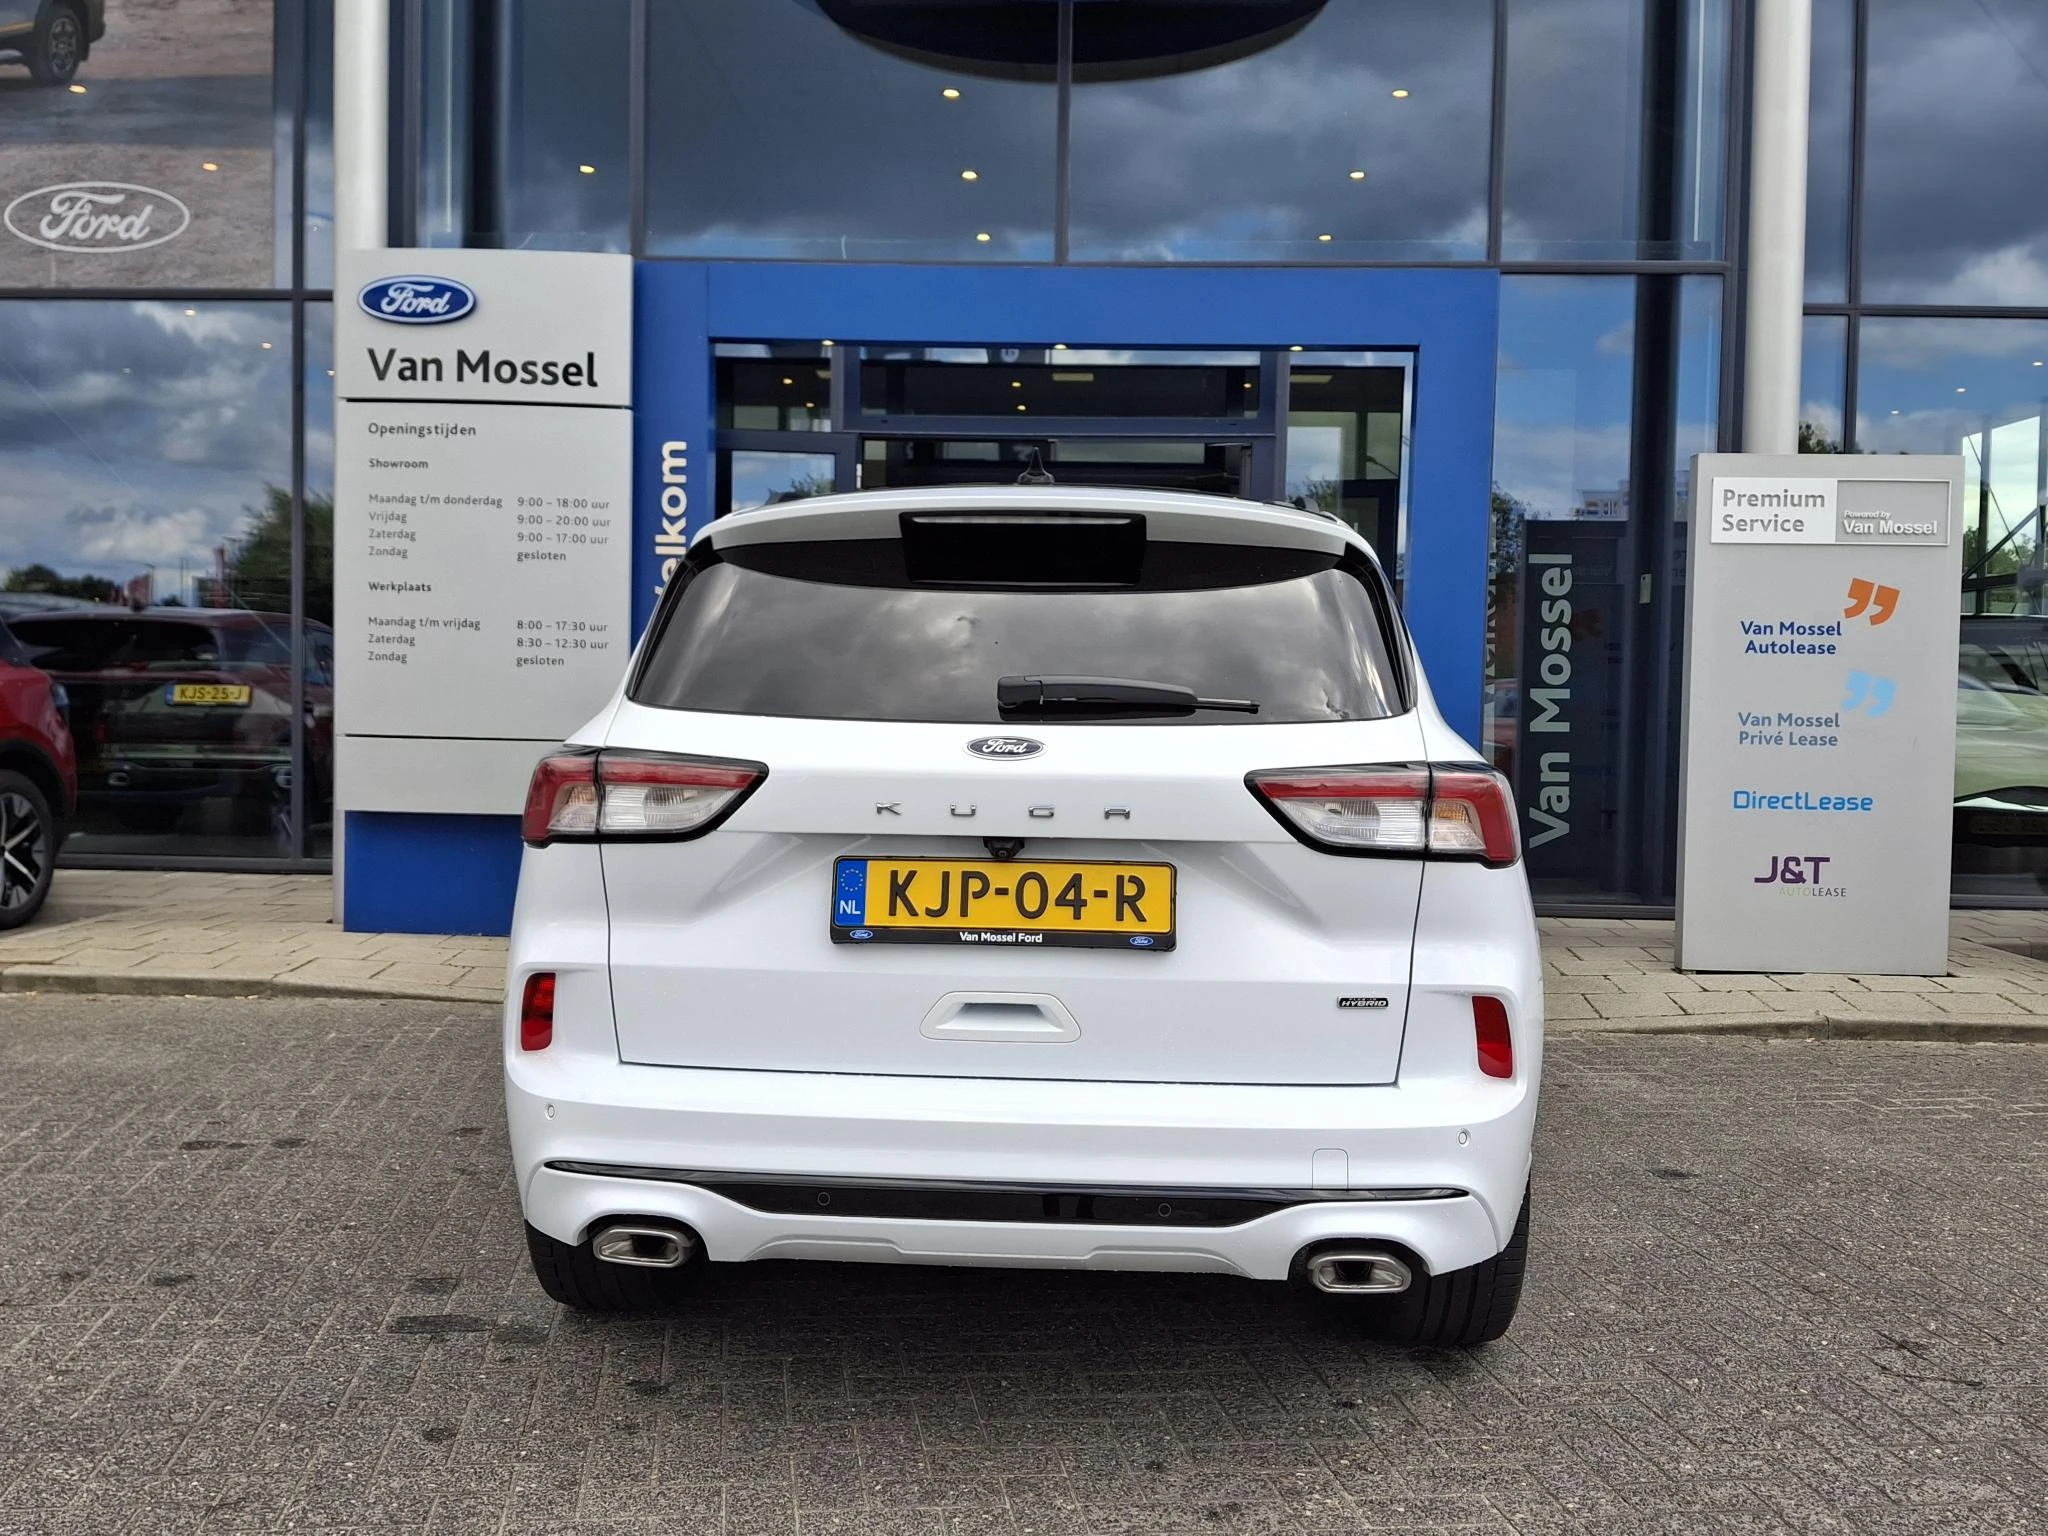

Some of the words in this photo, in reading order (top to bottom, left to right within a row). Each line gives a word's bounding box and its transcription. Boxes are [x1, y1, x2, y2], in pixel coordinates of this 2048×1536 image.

[39, 190, 154, 240] Ford
[379, 281, 452, 315] Ford
[366, 348, 443, 382] Van
[456, 349, 599, 388] Mossel
[368, 422, 477, 438] Openingstijden
[368, 457, 430, 470] Showroom
[368, 493, 417, 506] Maandag
[420, 493, 440, 506] t/m
[443, 494, 503, 509] donderdag
[516, 497, 543, 507] 9:00
[556, 498, 588, 509] 18:00
[591, 500, 610, 509] uur
[1722, 489, 1825, 508] Premium
[368, 511, 408, 525] Vrijdag
[516, 514, 543, 525] 9:00
[555, 515, 589, 527] 20:00
[592, 518, 612, 527] uur
[1721, 513, 1805, 533] Service
[1843, 509, 1878, 520] Powered
[1879, 510, 1892, 522] by
[368, 528, 417, 542] Zaterdag
[1843, 519, 1874, 535] Van
[1879, 520, 1938, 536] Mossel
[516, 532, 543, 543] 9:00
[555, 533, 587, 544] 17:00
[590, 535, 609, 545] uur
[368, 546, 408, 559] Zondag
[516, 550, 567, 562] gesloten
[368, 581, 432, 594] Werkplaats
[368, 616, 416, 630] Maandag
[419, 616, 440, 629] t/m
[443, 617, 481, 631] vrijdag
[516, 620, 543, 631] 8:00
[555, 621, 586, 632] 17:30
[589, 623, 608, 632] uur
[1740, 620, 1774, 636] Van
[1780, 621, 1842, 637] Mossel
[368, 633, 416, 647] Zaterdag
[516, 637, 543, 649] 8:30
[555, 638, 587, 650] 12:30
[590, 640, 608, 650] uur
[1528, 553, 1573, 733] Mossel
[1744, 639, 1837, 655] Autolease
[367, 651, 408, 664] Zondag
[516, 655, 565, 667] gesloten
[1738, 711, 1772, 728] Van
[1777, 712, 1841, 728] Mossel
[982, 738, 1028, 755] Ford
[1739, 730, 1783, 746] Privé
[1789, 731, 1839, 747] Lease
[1528, 751, 1571, 849] Van
[1733, 789, 1874, 812] DirectLease
[875, 801, 1131, 820] KUGA
[1754, 855, 1831, 885] J&T
[888, 869, 1148, 923] KJP-04-R
[1777, 886, 1848, 898] AUTOLEASE
[839, 899, 861, 916] NL
[959, 931, 979, 942] Van
[980, 932, 1016, 944] Mossel
[1018, 932, 1044, 944] Ford
